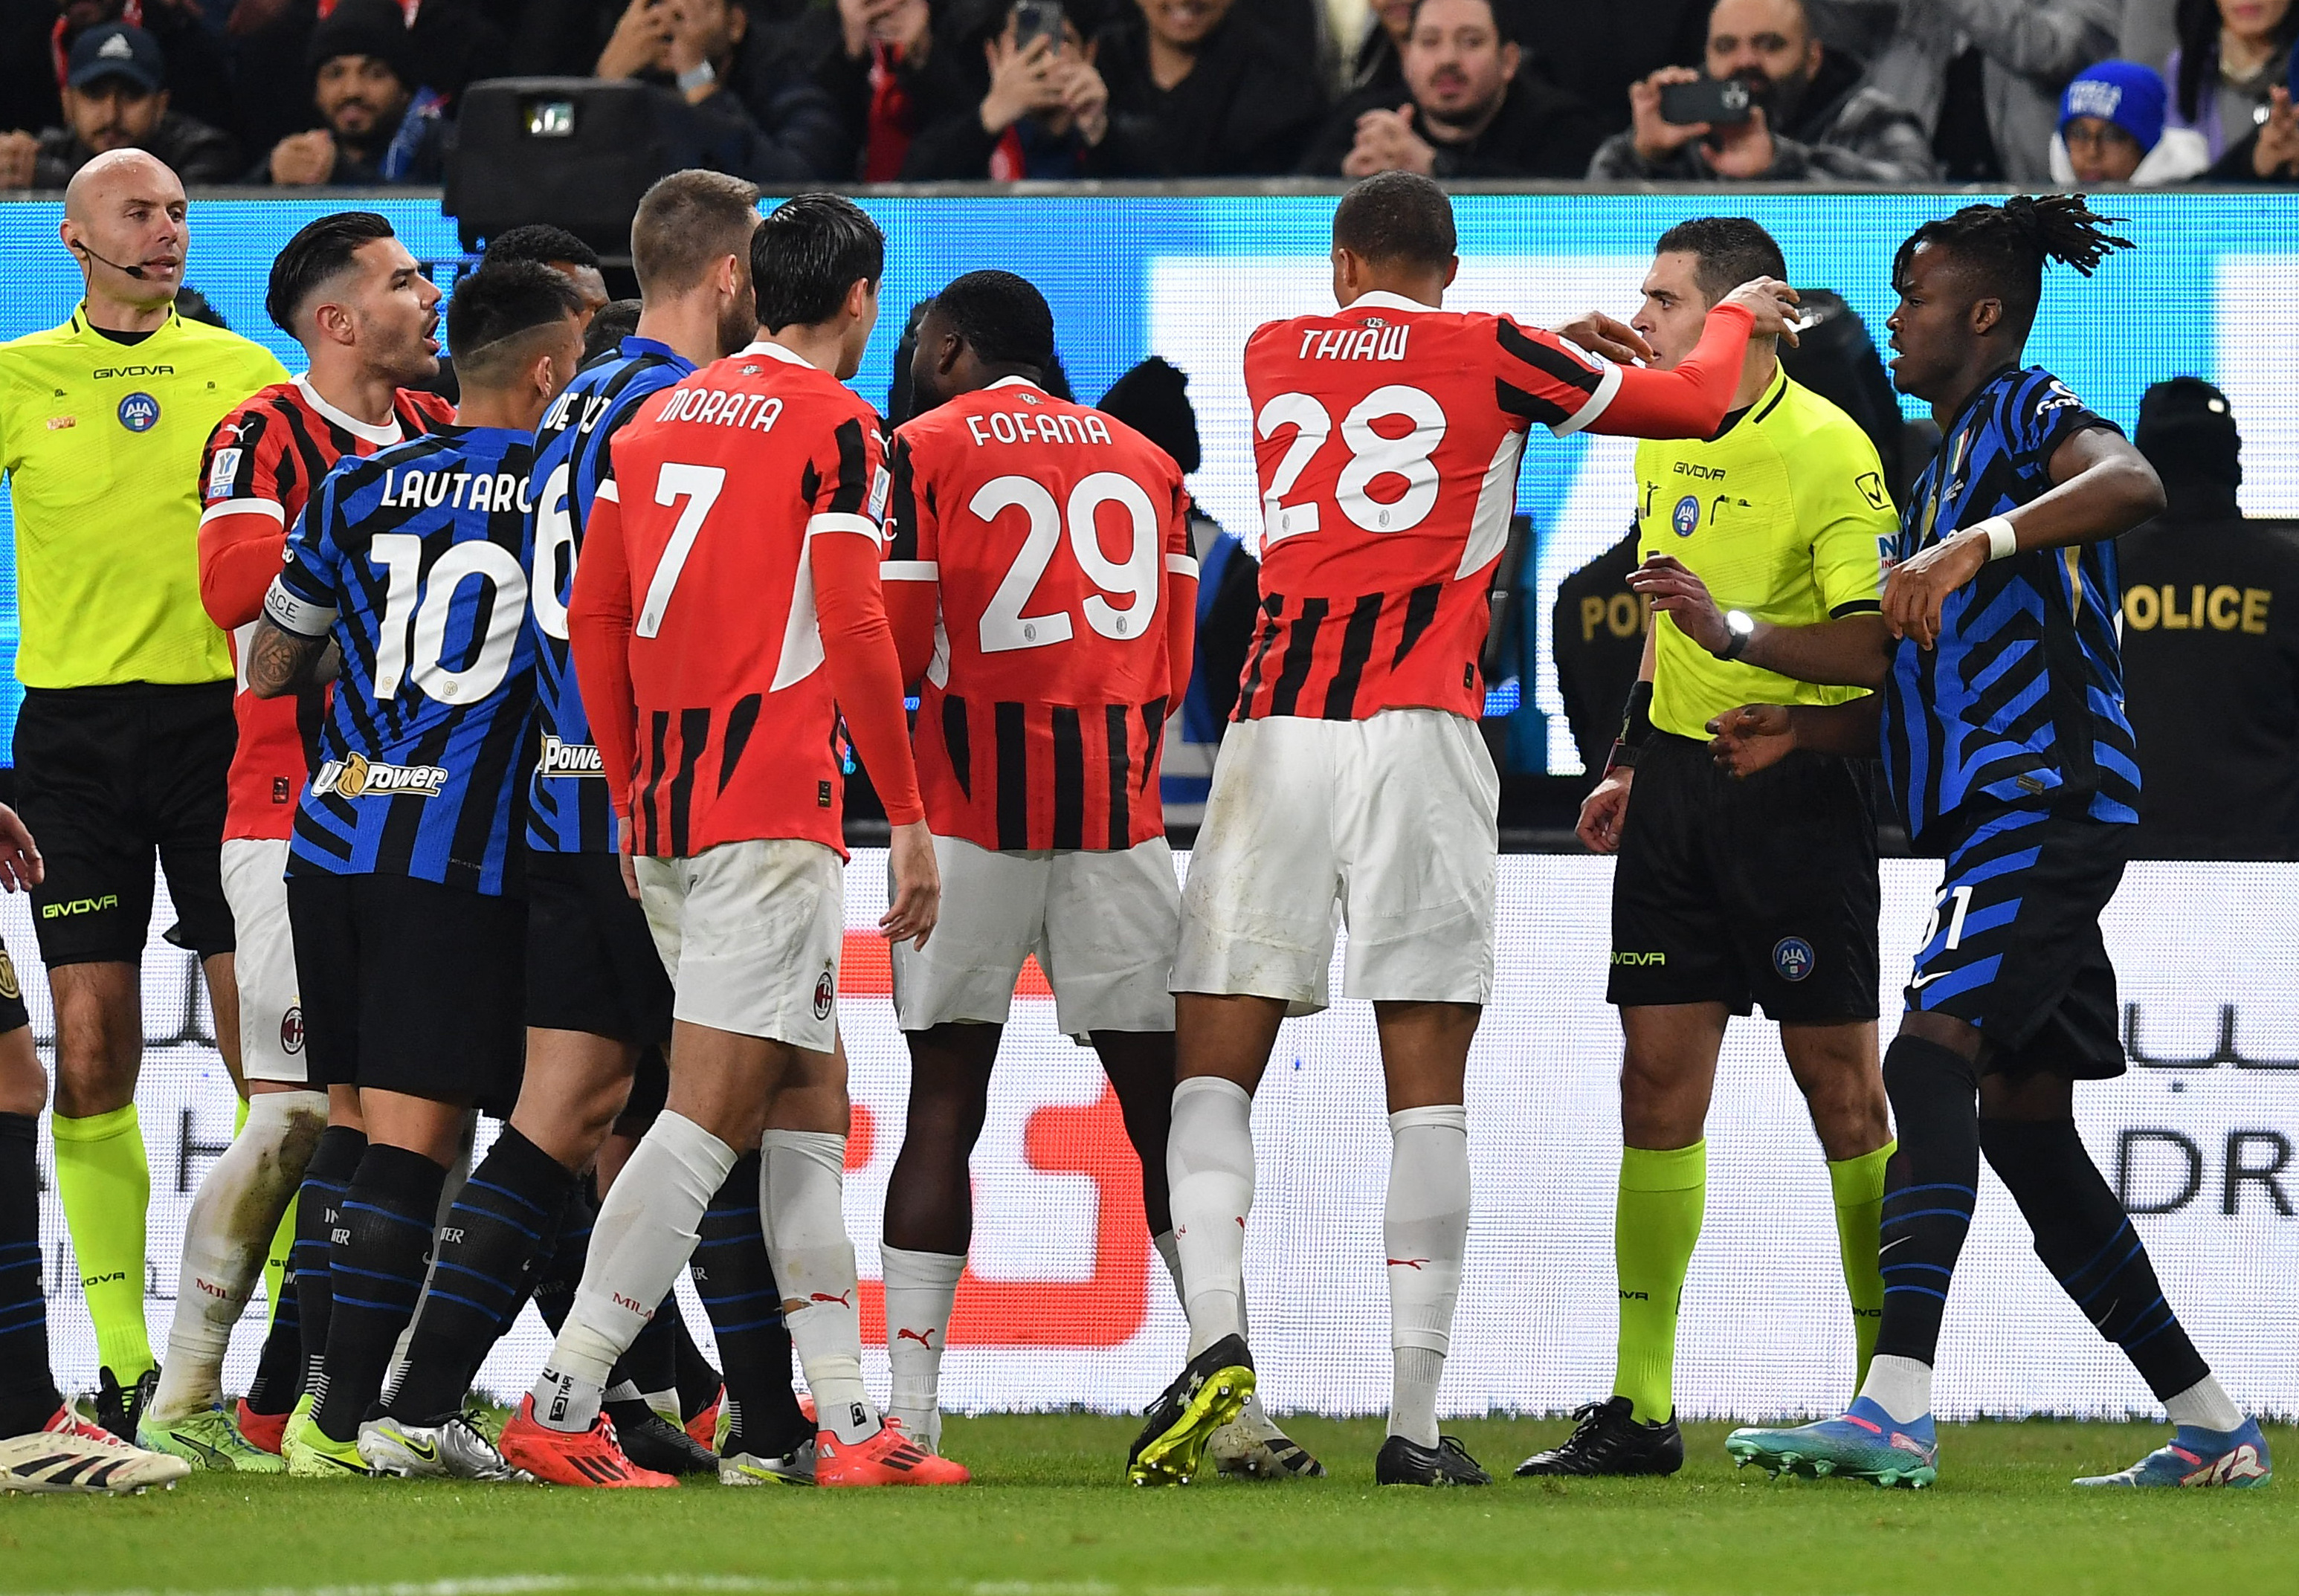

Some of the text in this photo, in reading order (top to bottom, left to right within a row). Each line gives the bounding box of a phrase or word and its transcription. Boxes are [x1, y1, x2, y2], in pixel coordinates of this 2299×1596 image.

[1299, 325, 1409, 361] THIAW
[93, 365, 175, 380] GIVOVA
[544, 392, 579, 431] DE
[656, 387, 784, 433] MORATA
[966, 413, 1112, 446] FOFANA
[1257, 384, 1447, 546] 28
[1673, 462, 1726, 481] GIVOVA
[213, 485, 228, 495] 07
[635, 462, 726, 638] 7
[968, 471, 1158, 653] 29
[370, 534, 529, 705] 10
[2121, 584, 2273, 636] OLICE
[543, 737, 604, 774] Powe
[42, 894, 117, 918] GIVOVA
[2120, 1130, 2294, 1216] DR
